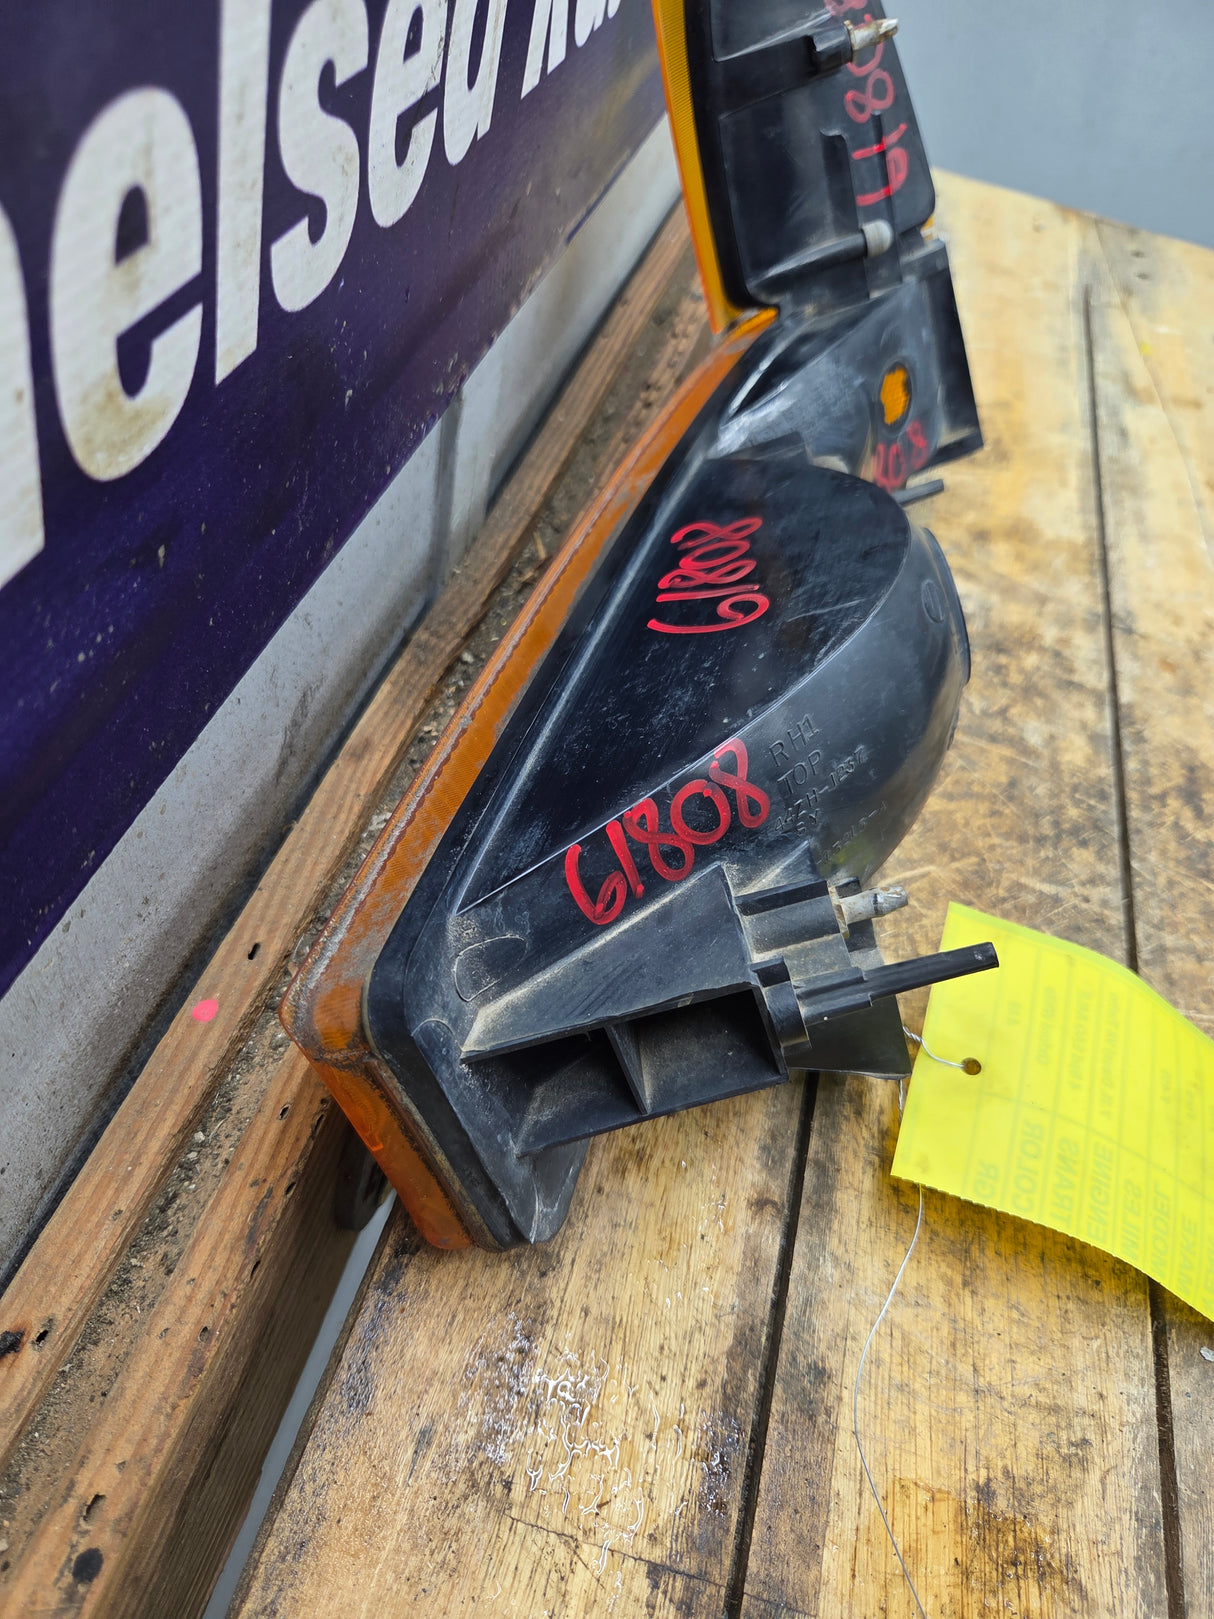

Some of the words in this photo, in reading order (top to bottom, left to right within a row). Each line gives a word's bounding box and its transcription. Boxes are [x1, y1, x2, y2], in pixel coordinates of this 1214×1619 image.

[647, 516, 770, 634] 61808
[565, 737, 770, 925] 61808
[777, 749, 822, 795] TOP
